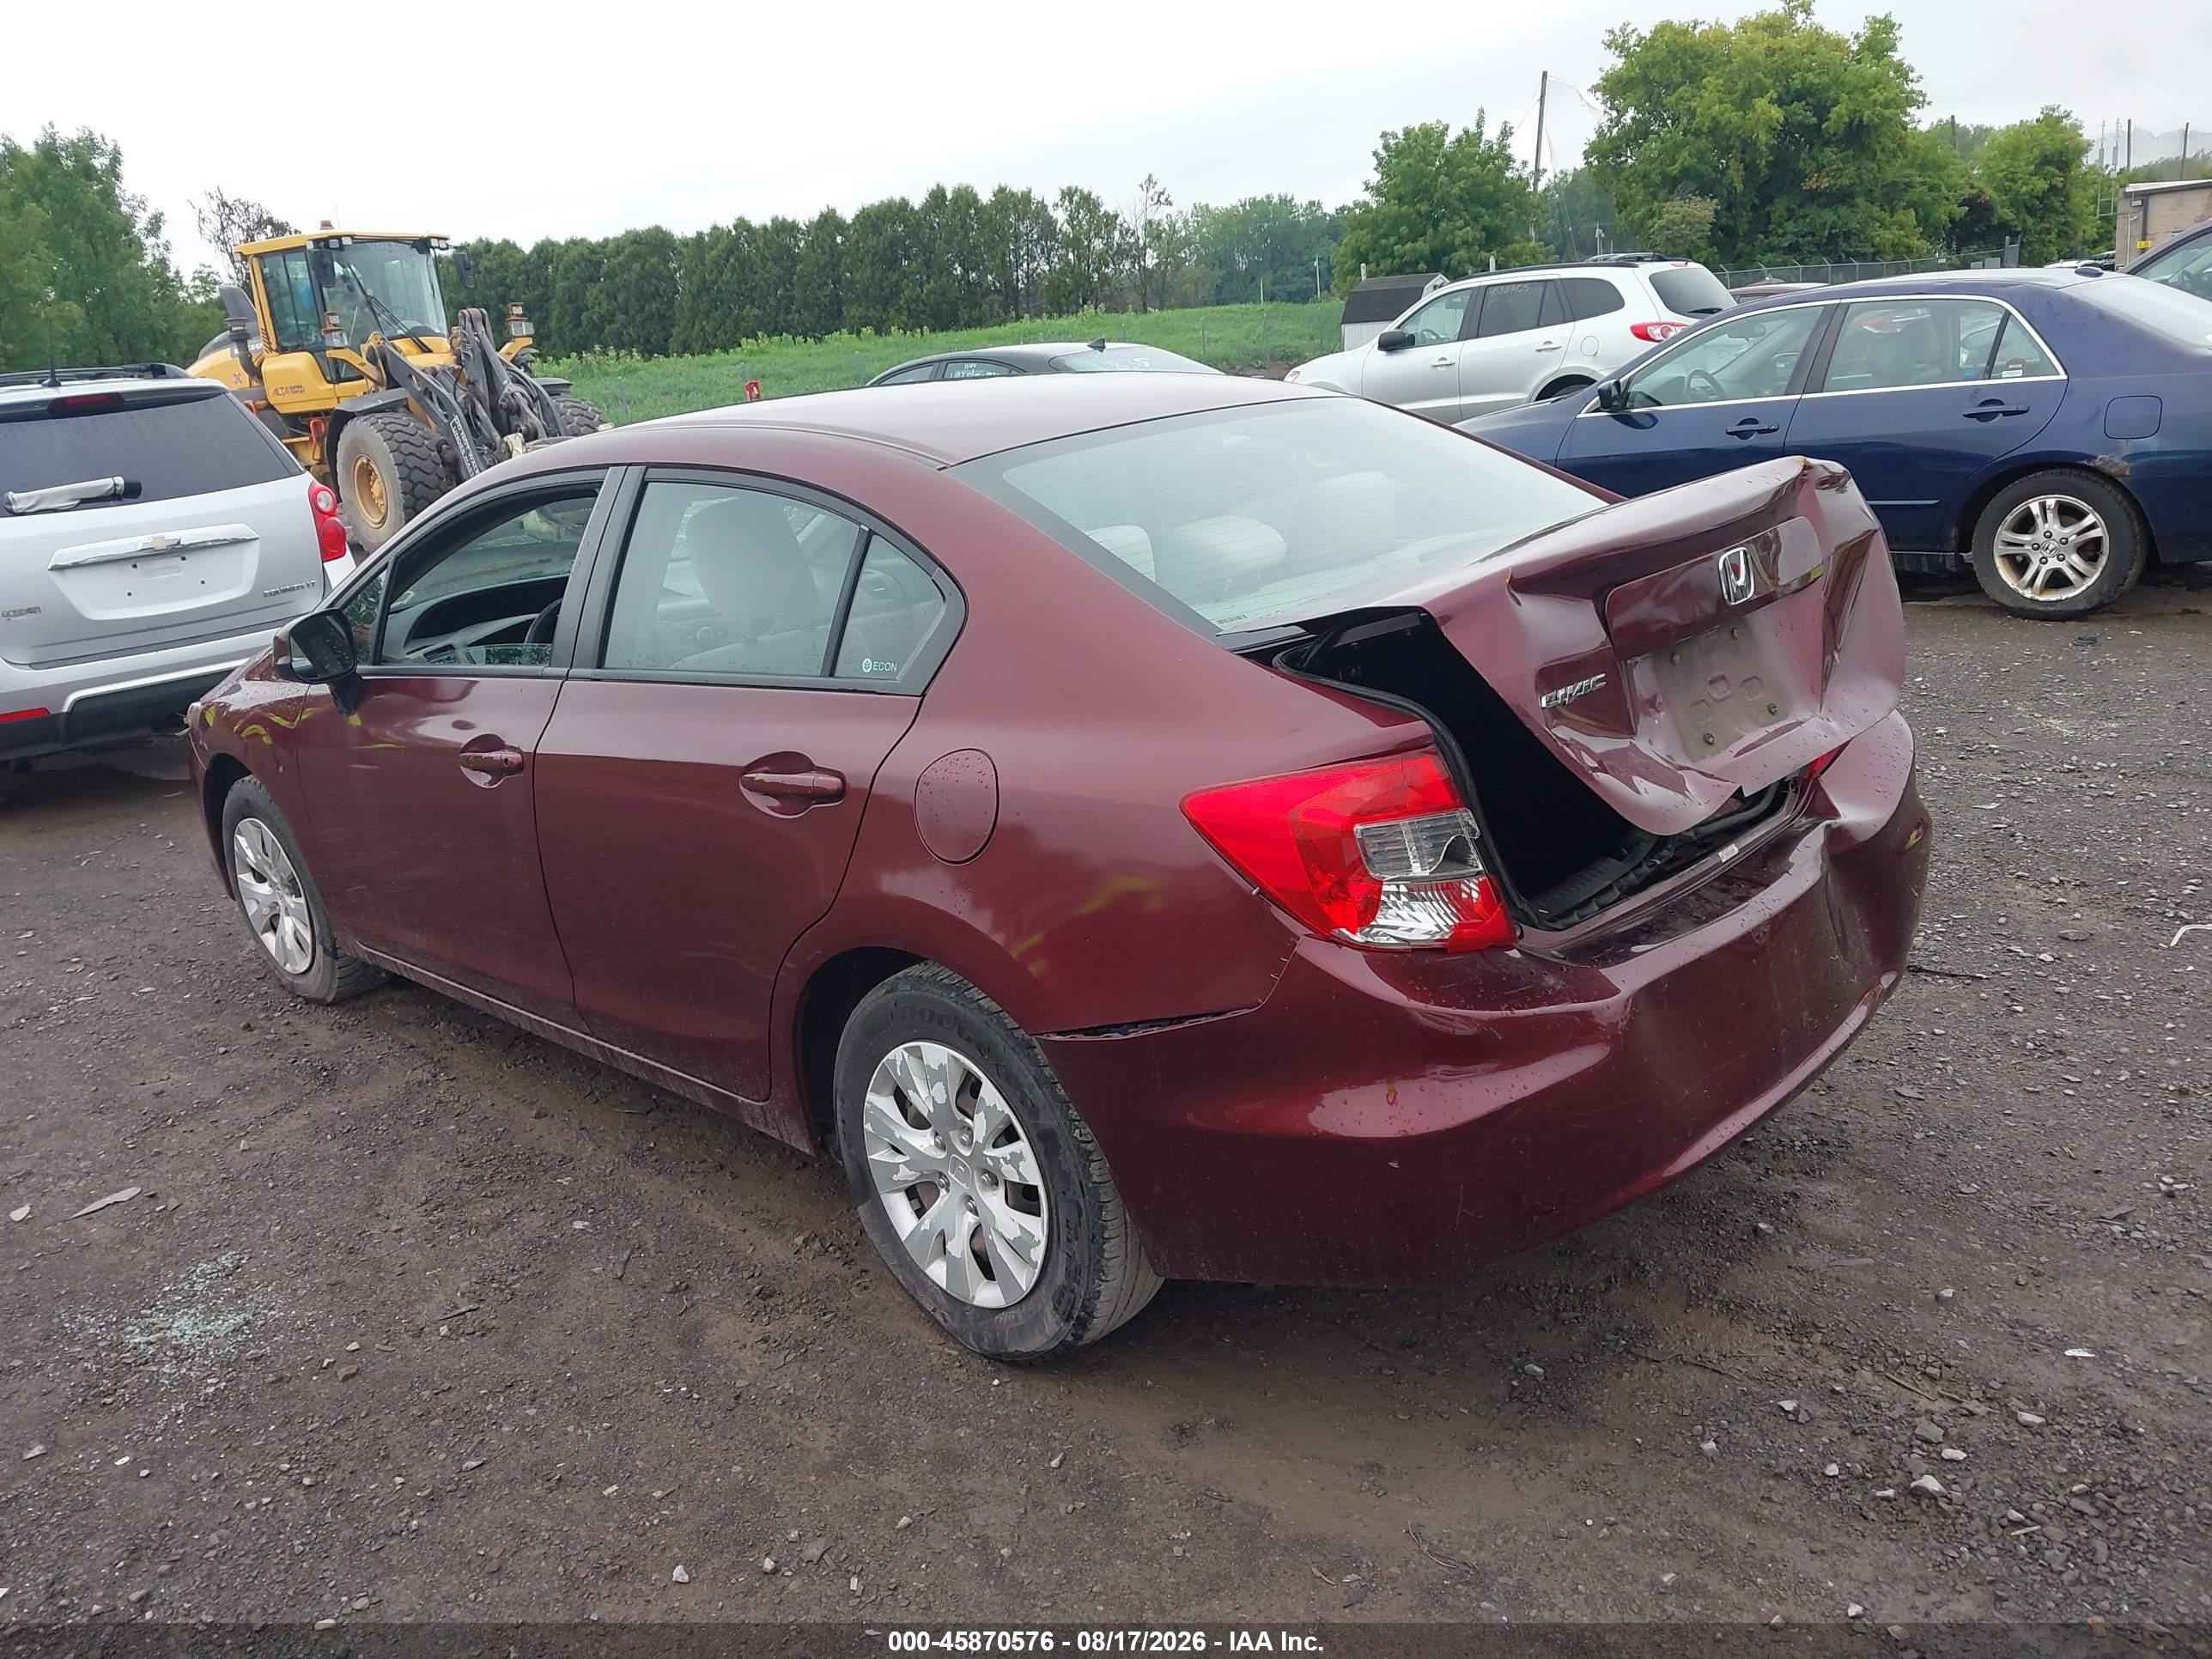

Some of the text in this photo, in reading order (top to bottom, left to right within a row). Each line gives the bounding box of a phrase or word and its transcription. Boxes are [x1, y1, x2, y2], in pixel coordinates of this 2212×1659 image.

[273, 386, 289, 397] ALTA
[306, 580, 317, 588] LT
[872, 660, 898, 672] ECON
[1538, 672, 1607, 708] CIVIC
